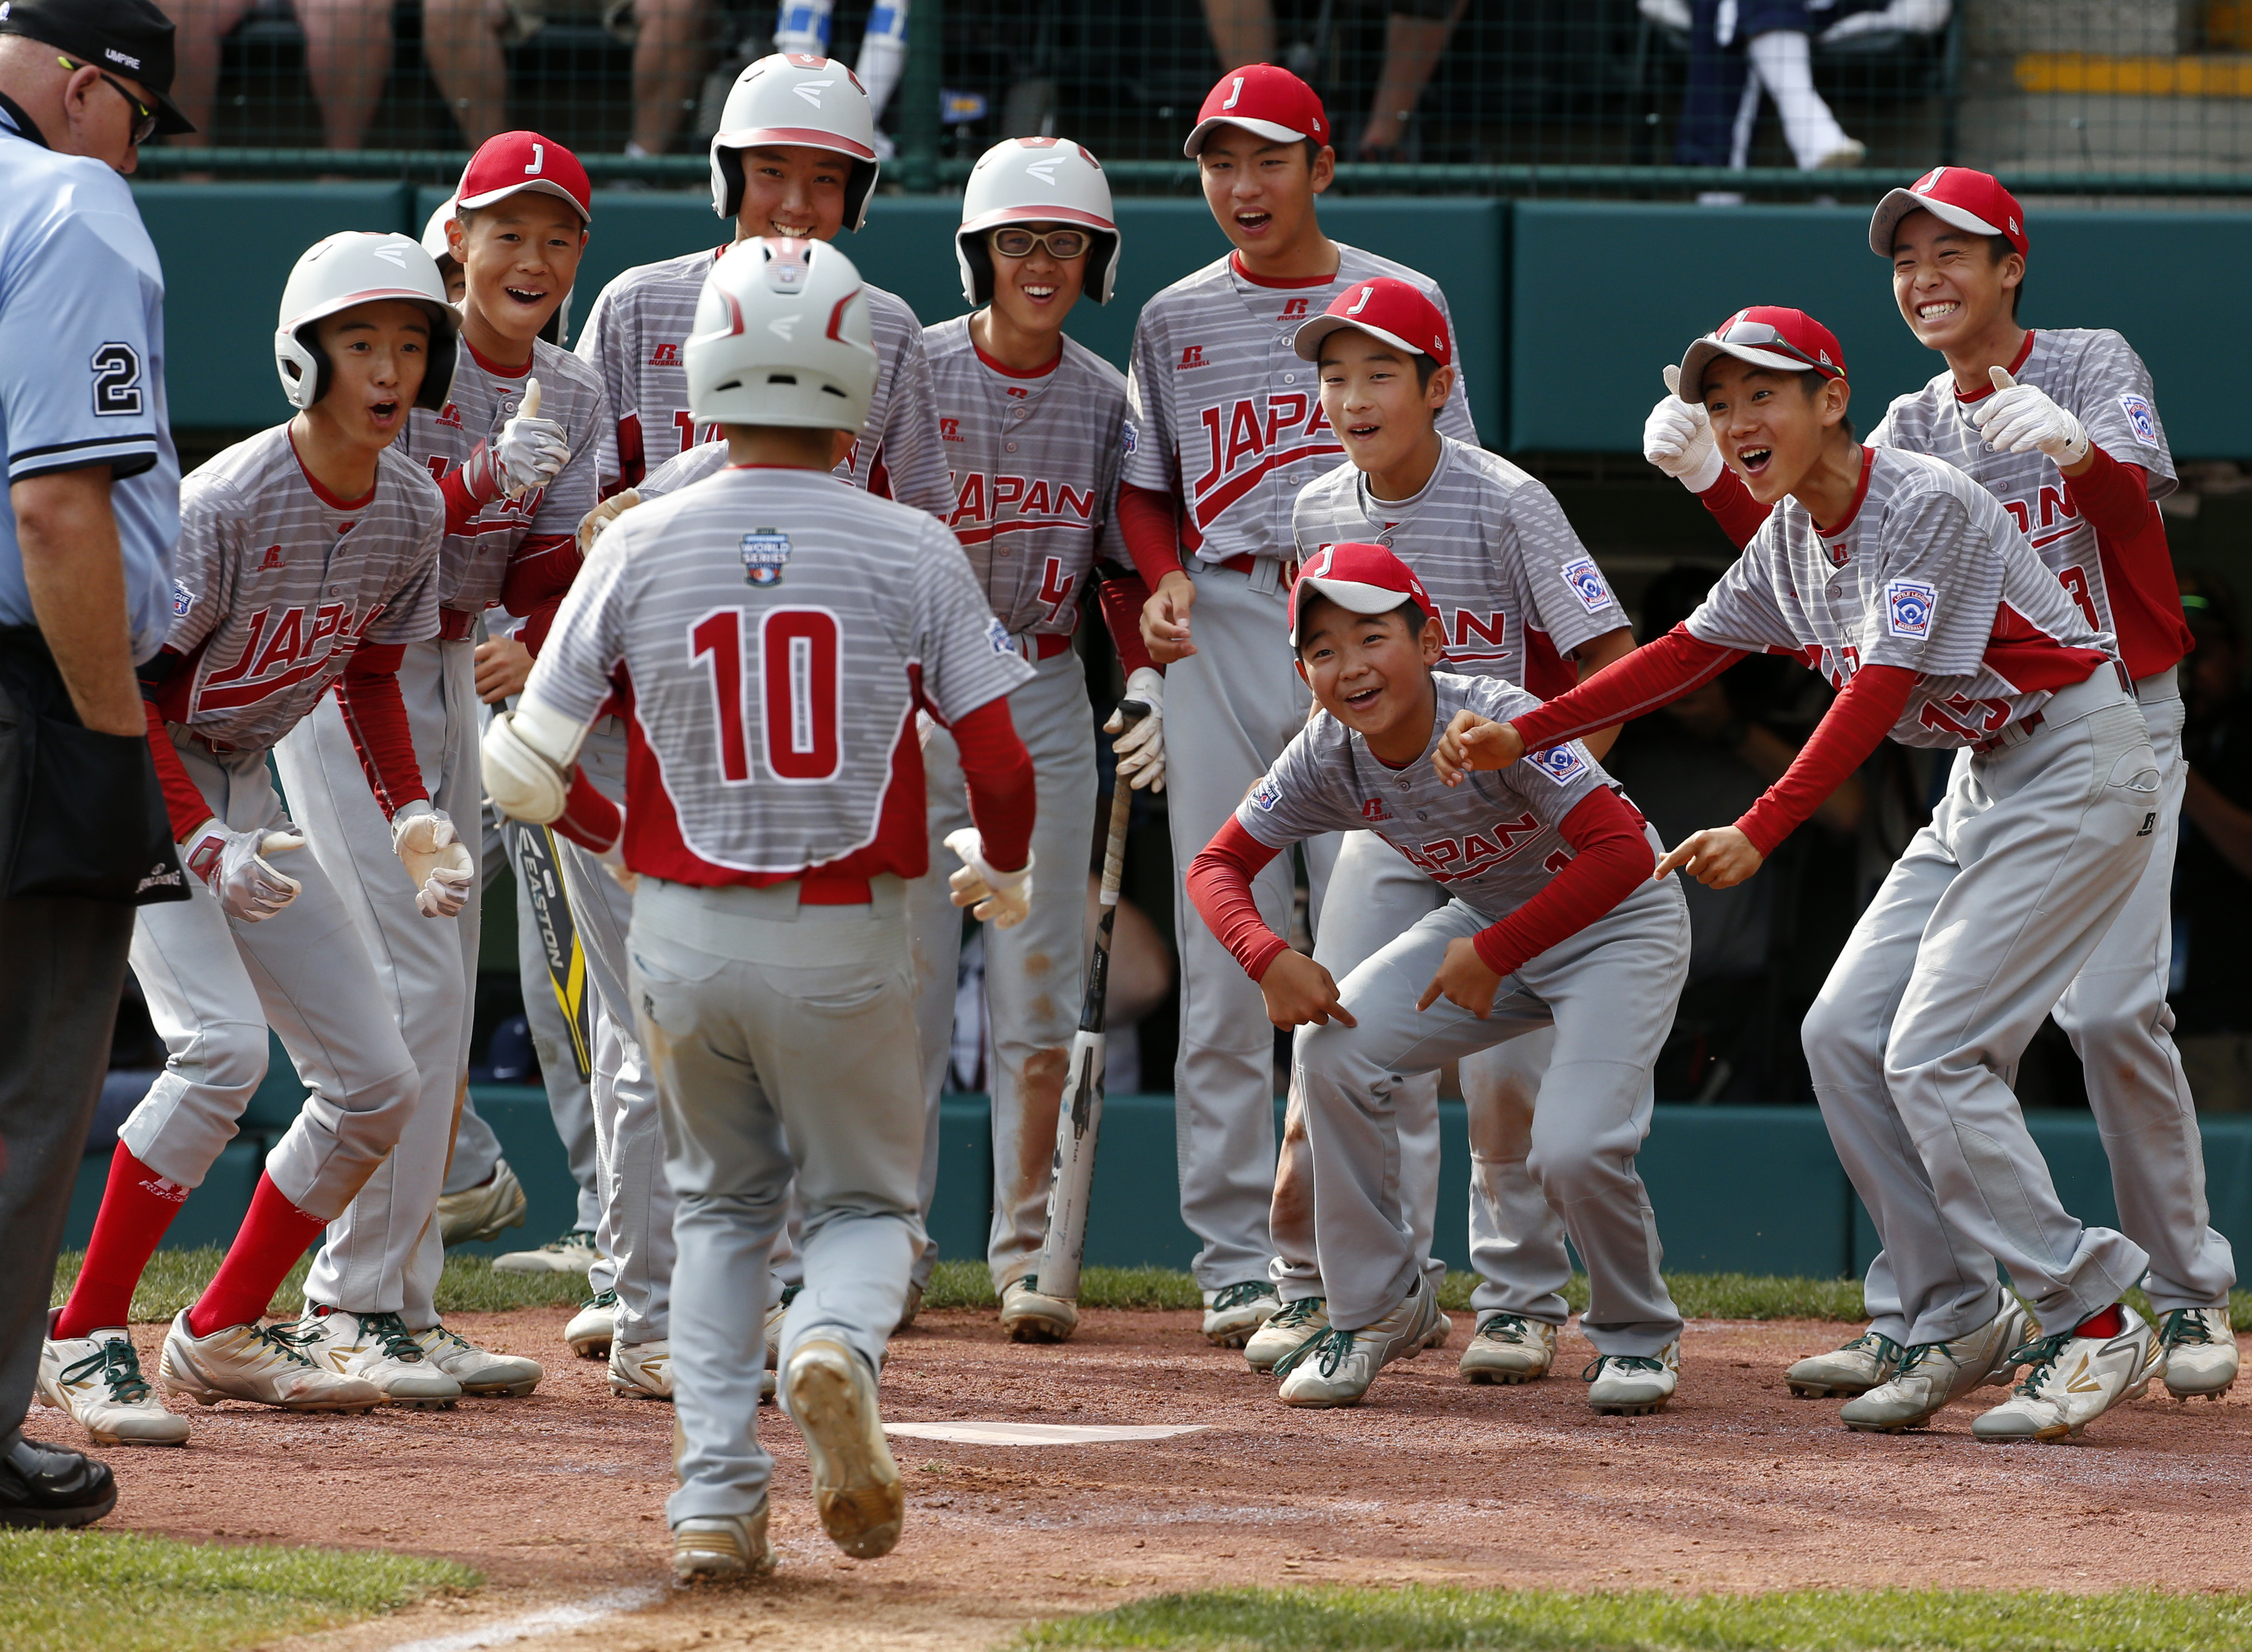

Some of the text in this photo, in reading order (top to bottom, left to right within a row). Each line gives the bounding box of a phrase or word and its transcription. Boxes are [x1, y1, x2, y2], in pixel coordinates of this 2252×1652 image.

[106, 48, 140, 70] UMPIRE
[1222, 77, 1244, 110] J
[525, 143, 543, 174] J
[1346, 287, 1374, 315] J
[91, 342, 143, 417] 2
[1177, 359, 1210, 370] RUSSELL
[1193, 391, 1338, 504] JAPA
[937, 471, 1095, 527] APAN
[741, 542, 791, 553] WORLD
[1315, 545, 1335, 578] J
[1037, 555, 1077, 624] 4
[1894, 592, 1930, 605] LITTLE LEAGUE
[1897, 622, 1924, 631] BASEBALL
[686, 604, 844, 786] 10
[1918, 690, 2013, 741] 15
[1366, 812, 1394, 822] SSELL
[524, 856, 565, 969] EASTON
